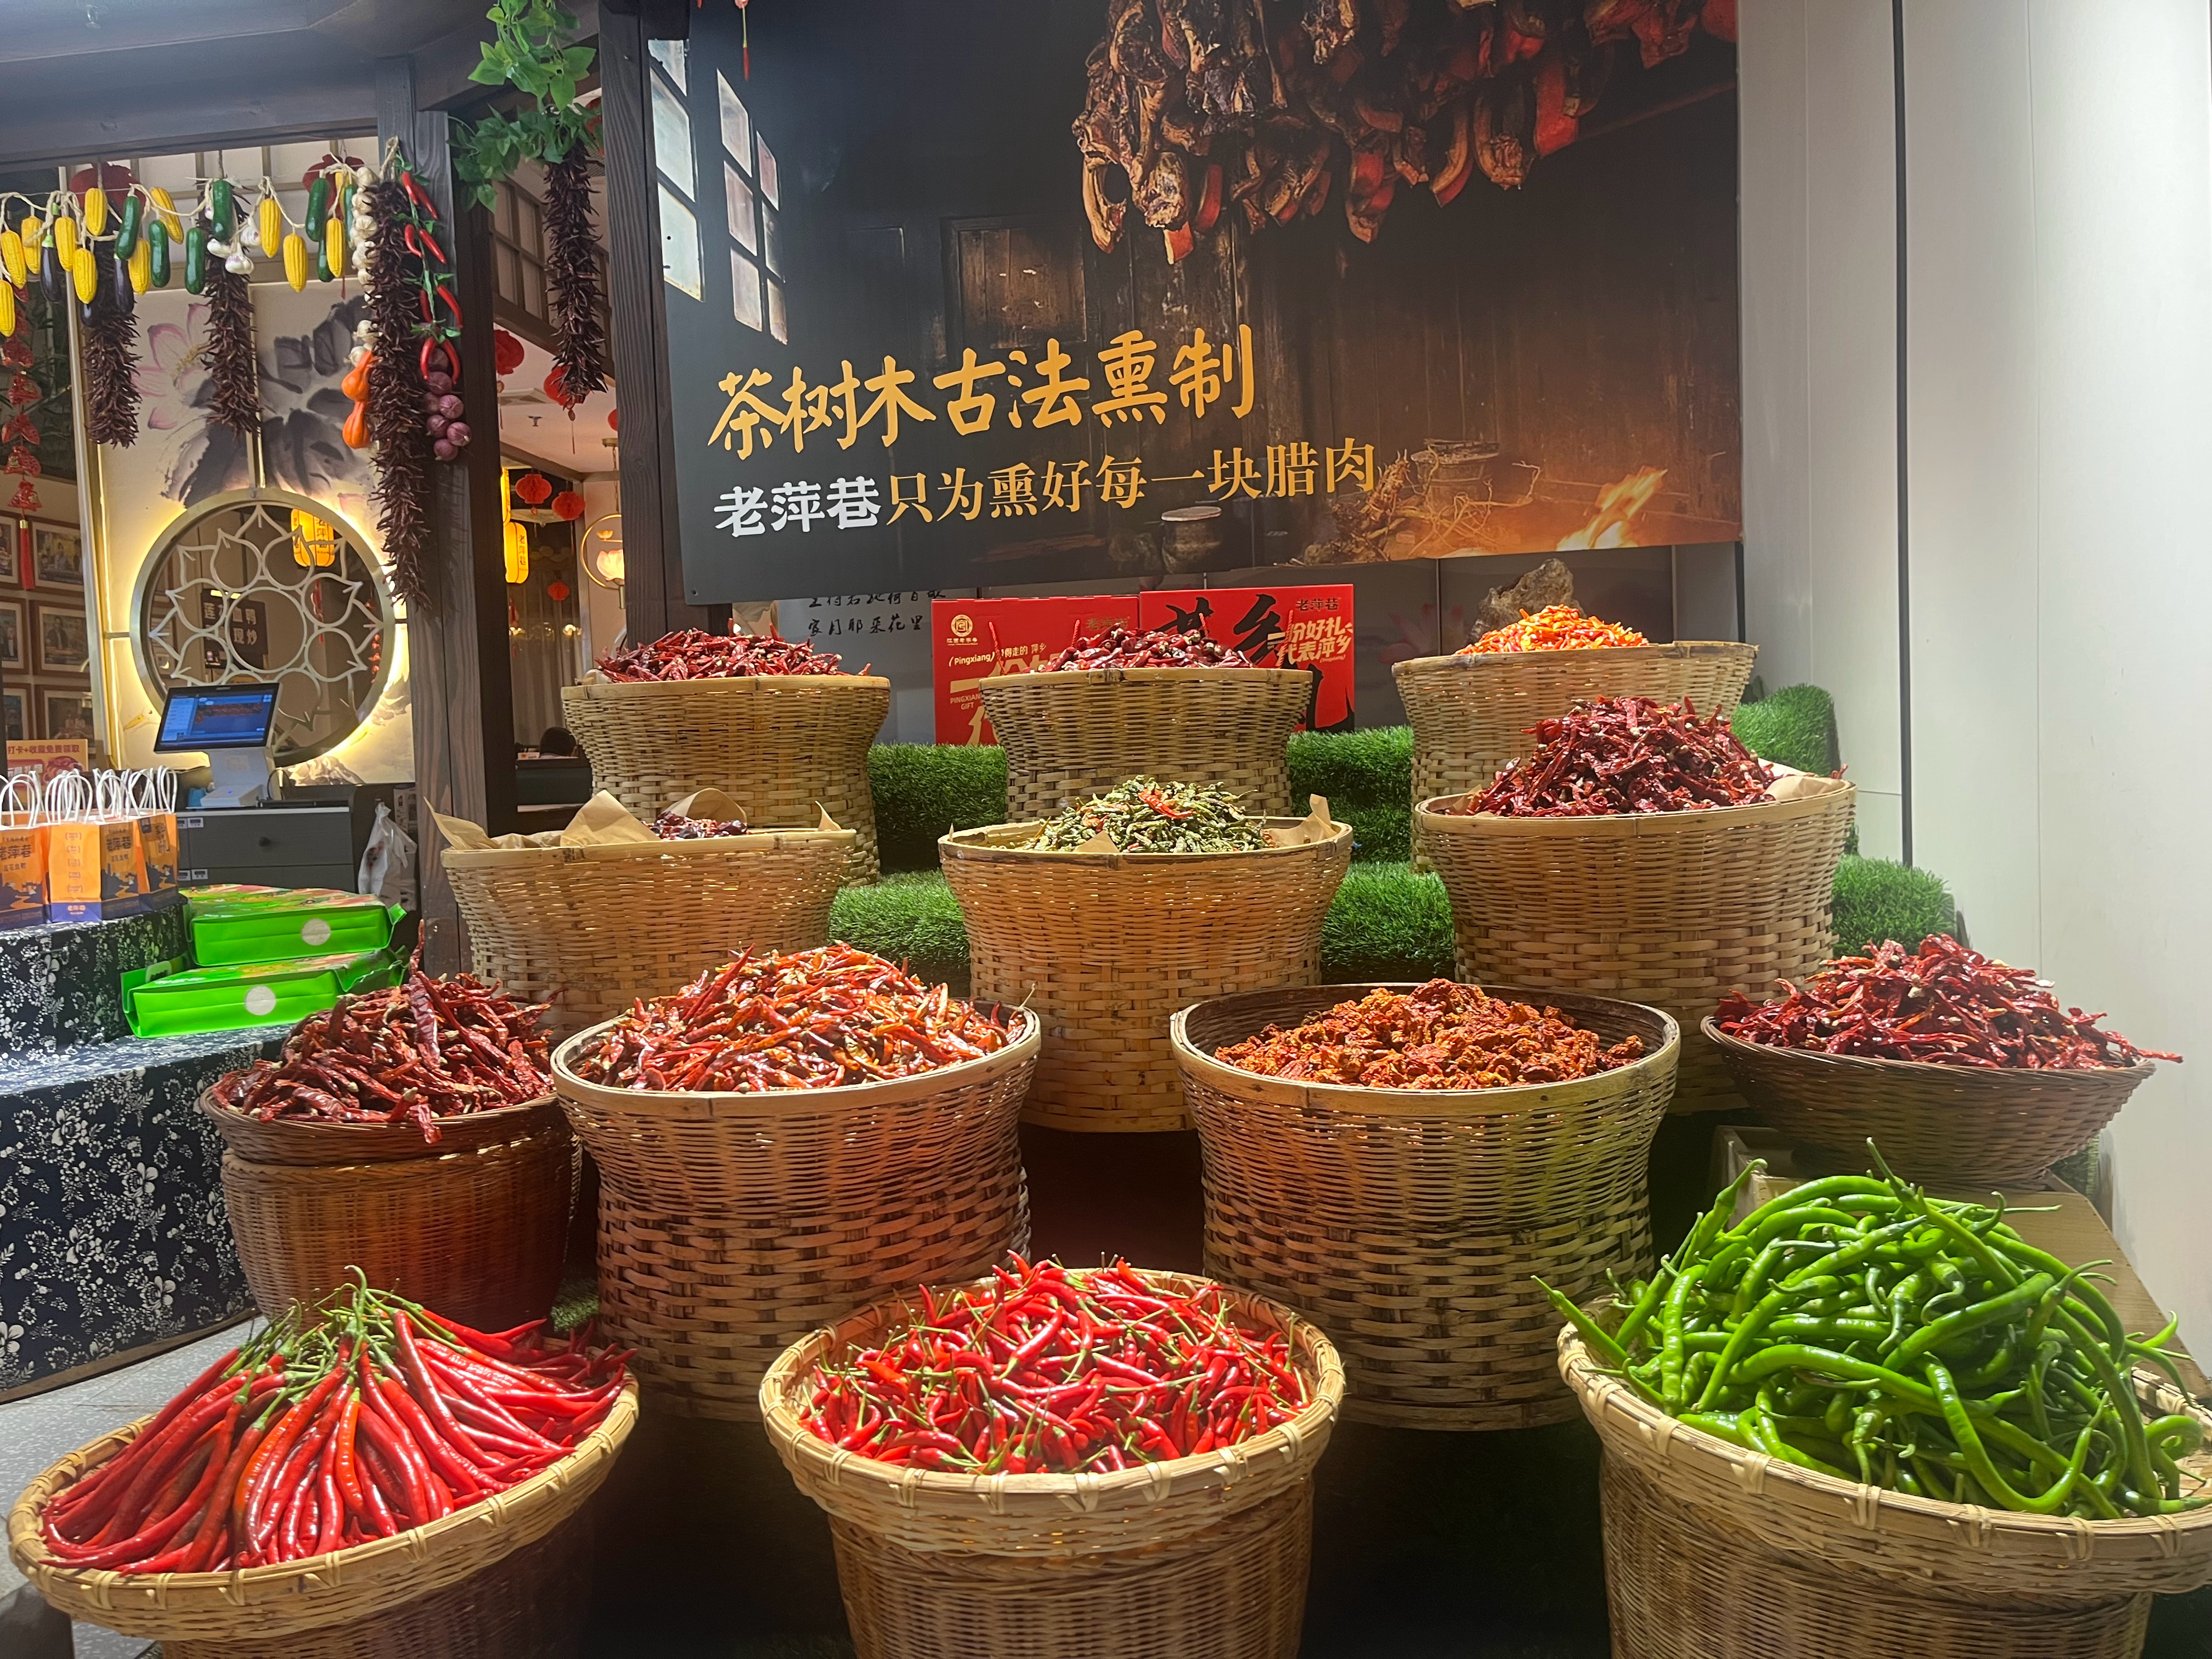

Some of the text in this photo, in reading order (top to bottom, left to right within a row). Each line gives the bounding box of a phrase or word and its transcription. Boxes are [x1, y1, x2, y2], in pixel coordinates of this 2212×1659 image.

[708, 324, 1254, 460] 茶树木古法熏制
[714, 438, 1374, 537] 老萍巷只为熏好每一块腊肉
[1295, 597, 1339, 611] 老萍巷
[949, 651, 995, 667] (Pingxiang)
[1001, 646, 1028, 658] 得走的
[950, 693, 981, 704] PINGXIAN
[961, 702, 974, 710] GIFT
